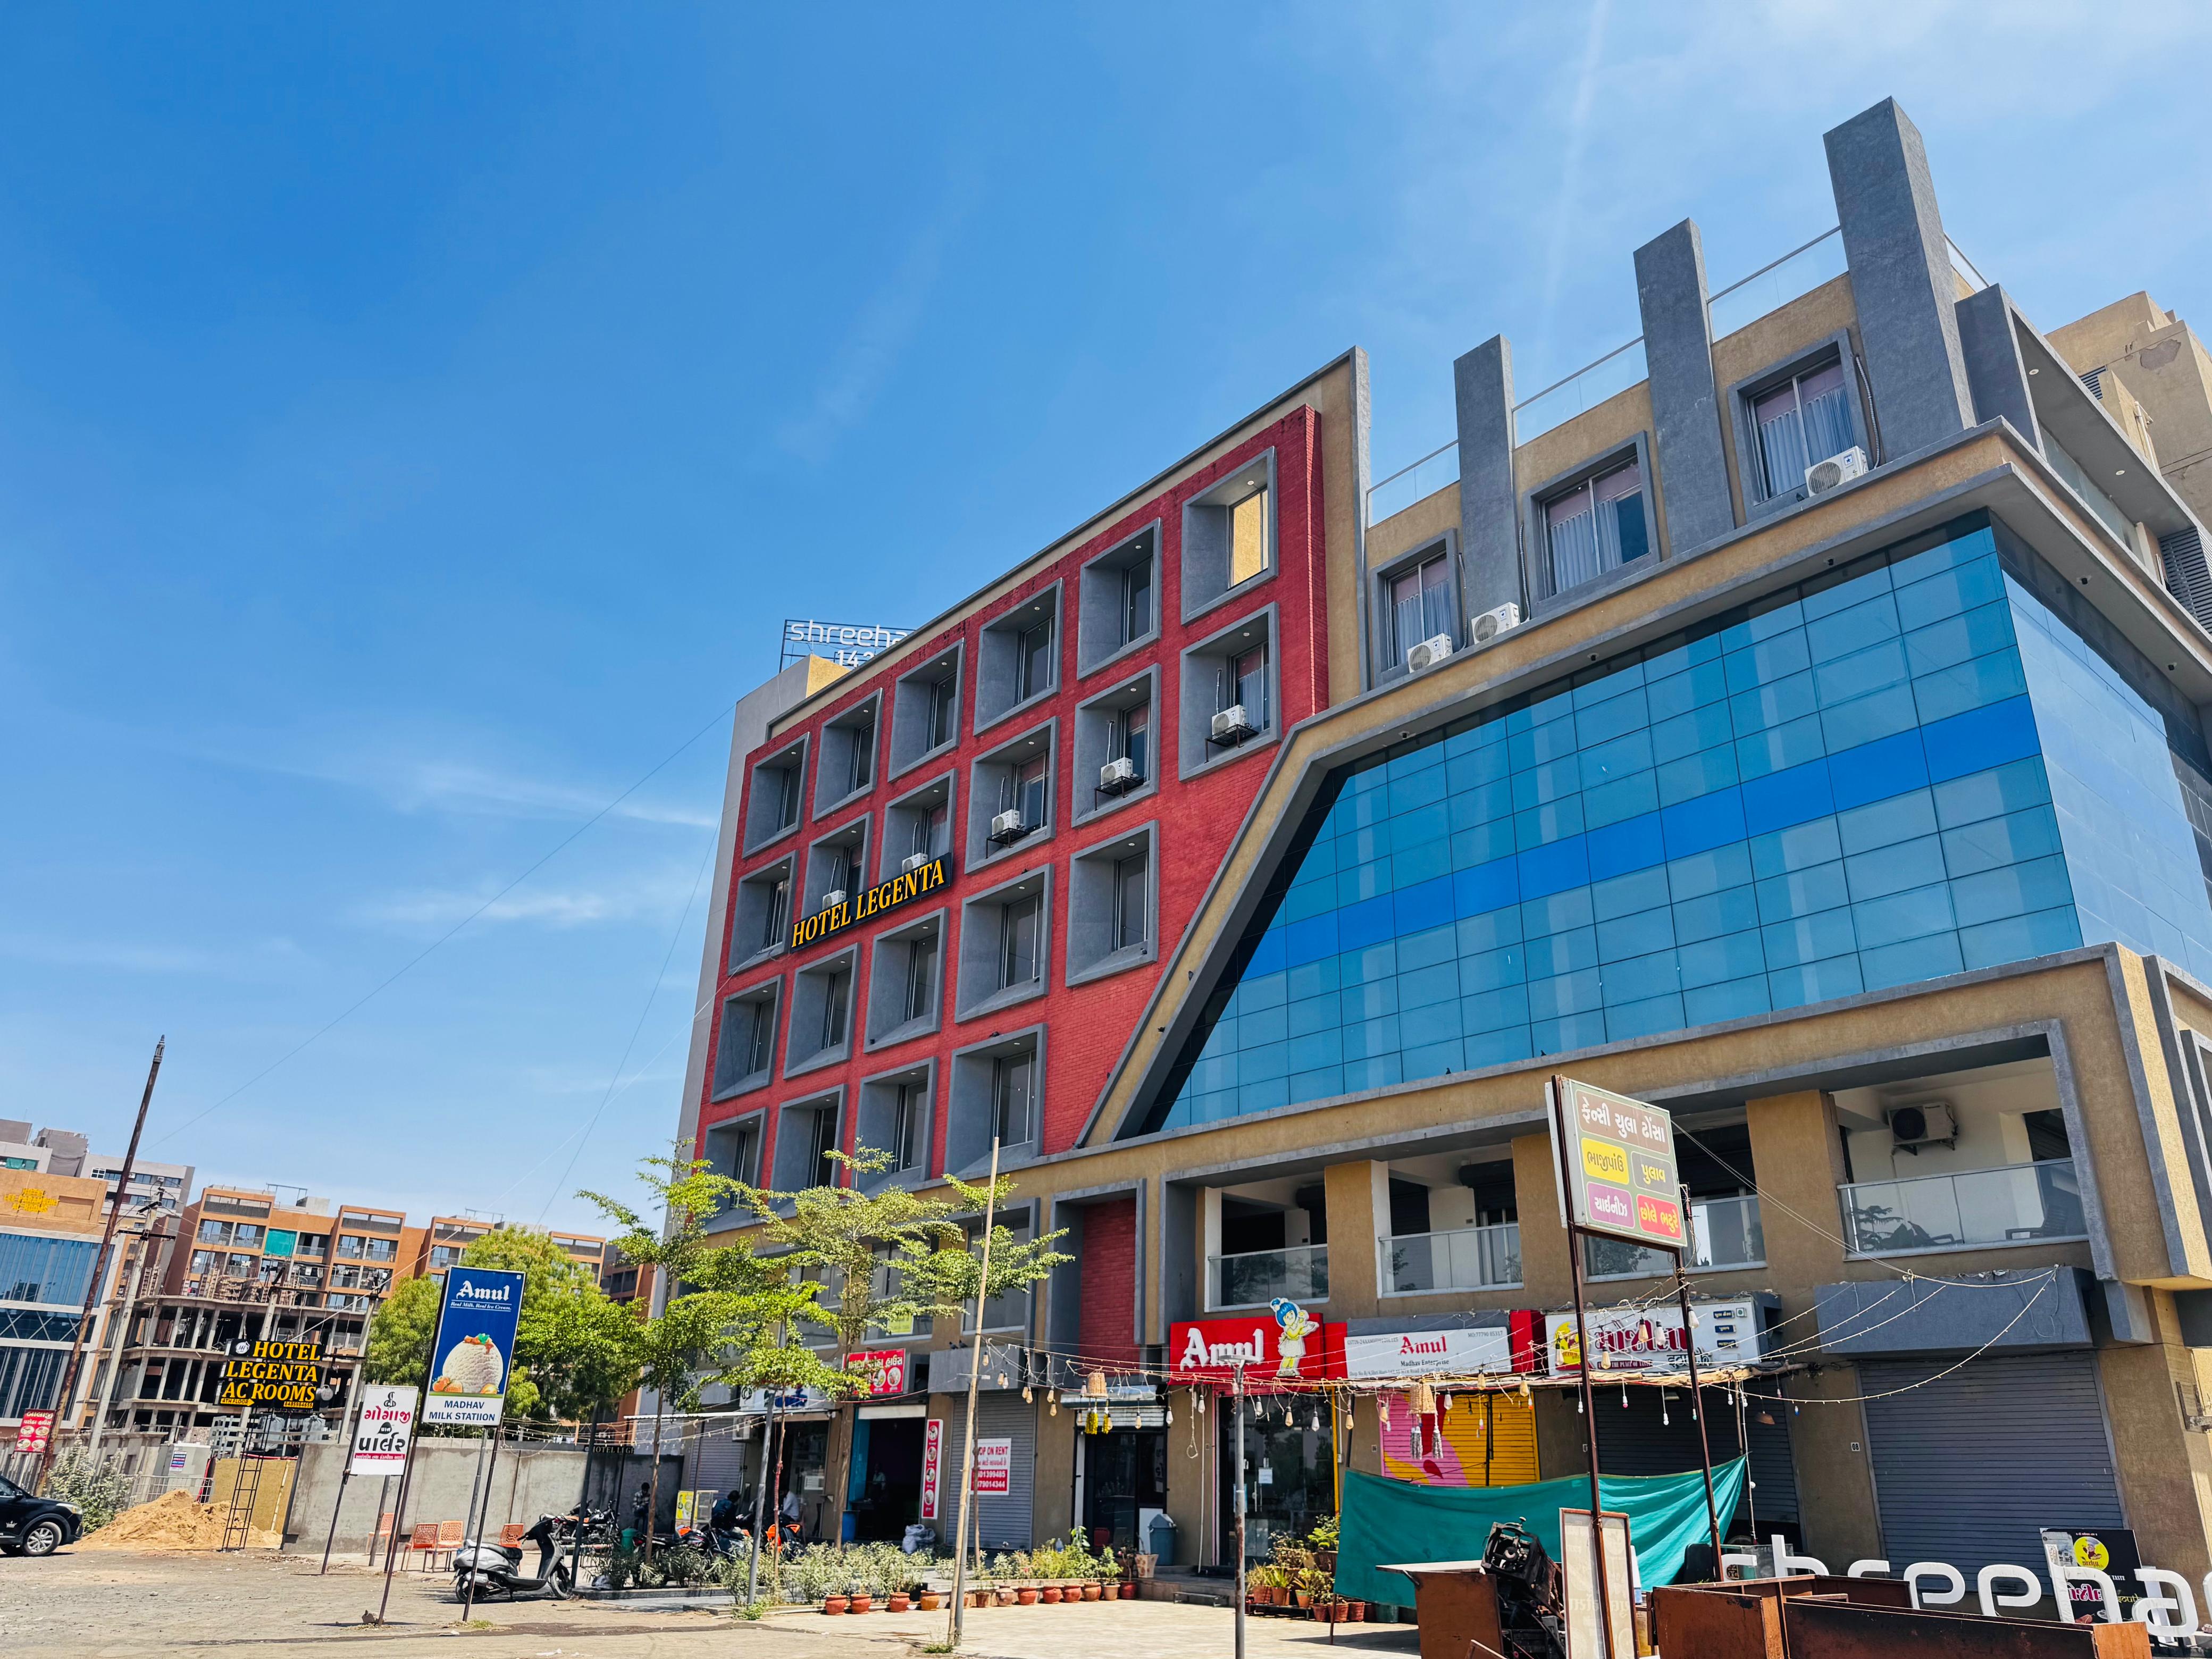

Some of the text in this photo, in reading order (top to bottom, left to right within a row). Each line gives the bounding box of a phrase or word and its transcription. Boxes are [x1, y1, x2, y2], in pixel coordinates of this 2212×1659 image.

[792, 859, 944, 948] HOTEL LEGENTA
[1581, 1096, 1611, 1126] ફેન્સી
[1615, 1112, 1637, 1138] ચુલા
[1641, 1164, 1665, 1185] પુલાવ
[456, 1280, 510, 1301] Amul
[253, 1341, 320, 1361] HOTEL
[1180, 1327, 1266, 1371] Amul
[1400, 1335, 1447, 1355] Amul
[227, 1361, 317, 1382] LEGENTA
[222, 1381, 316, 1402] AC ROOMS
[364, 1405, 410, 1423] ગોગાજી
[445, 1400, 484, 1409] MADHAV
[359, 1432, 406, 1451] પાર્લર
[987, 1446, 994, 1455] ON
[996, 1446, 1008, 1455] RENT
